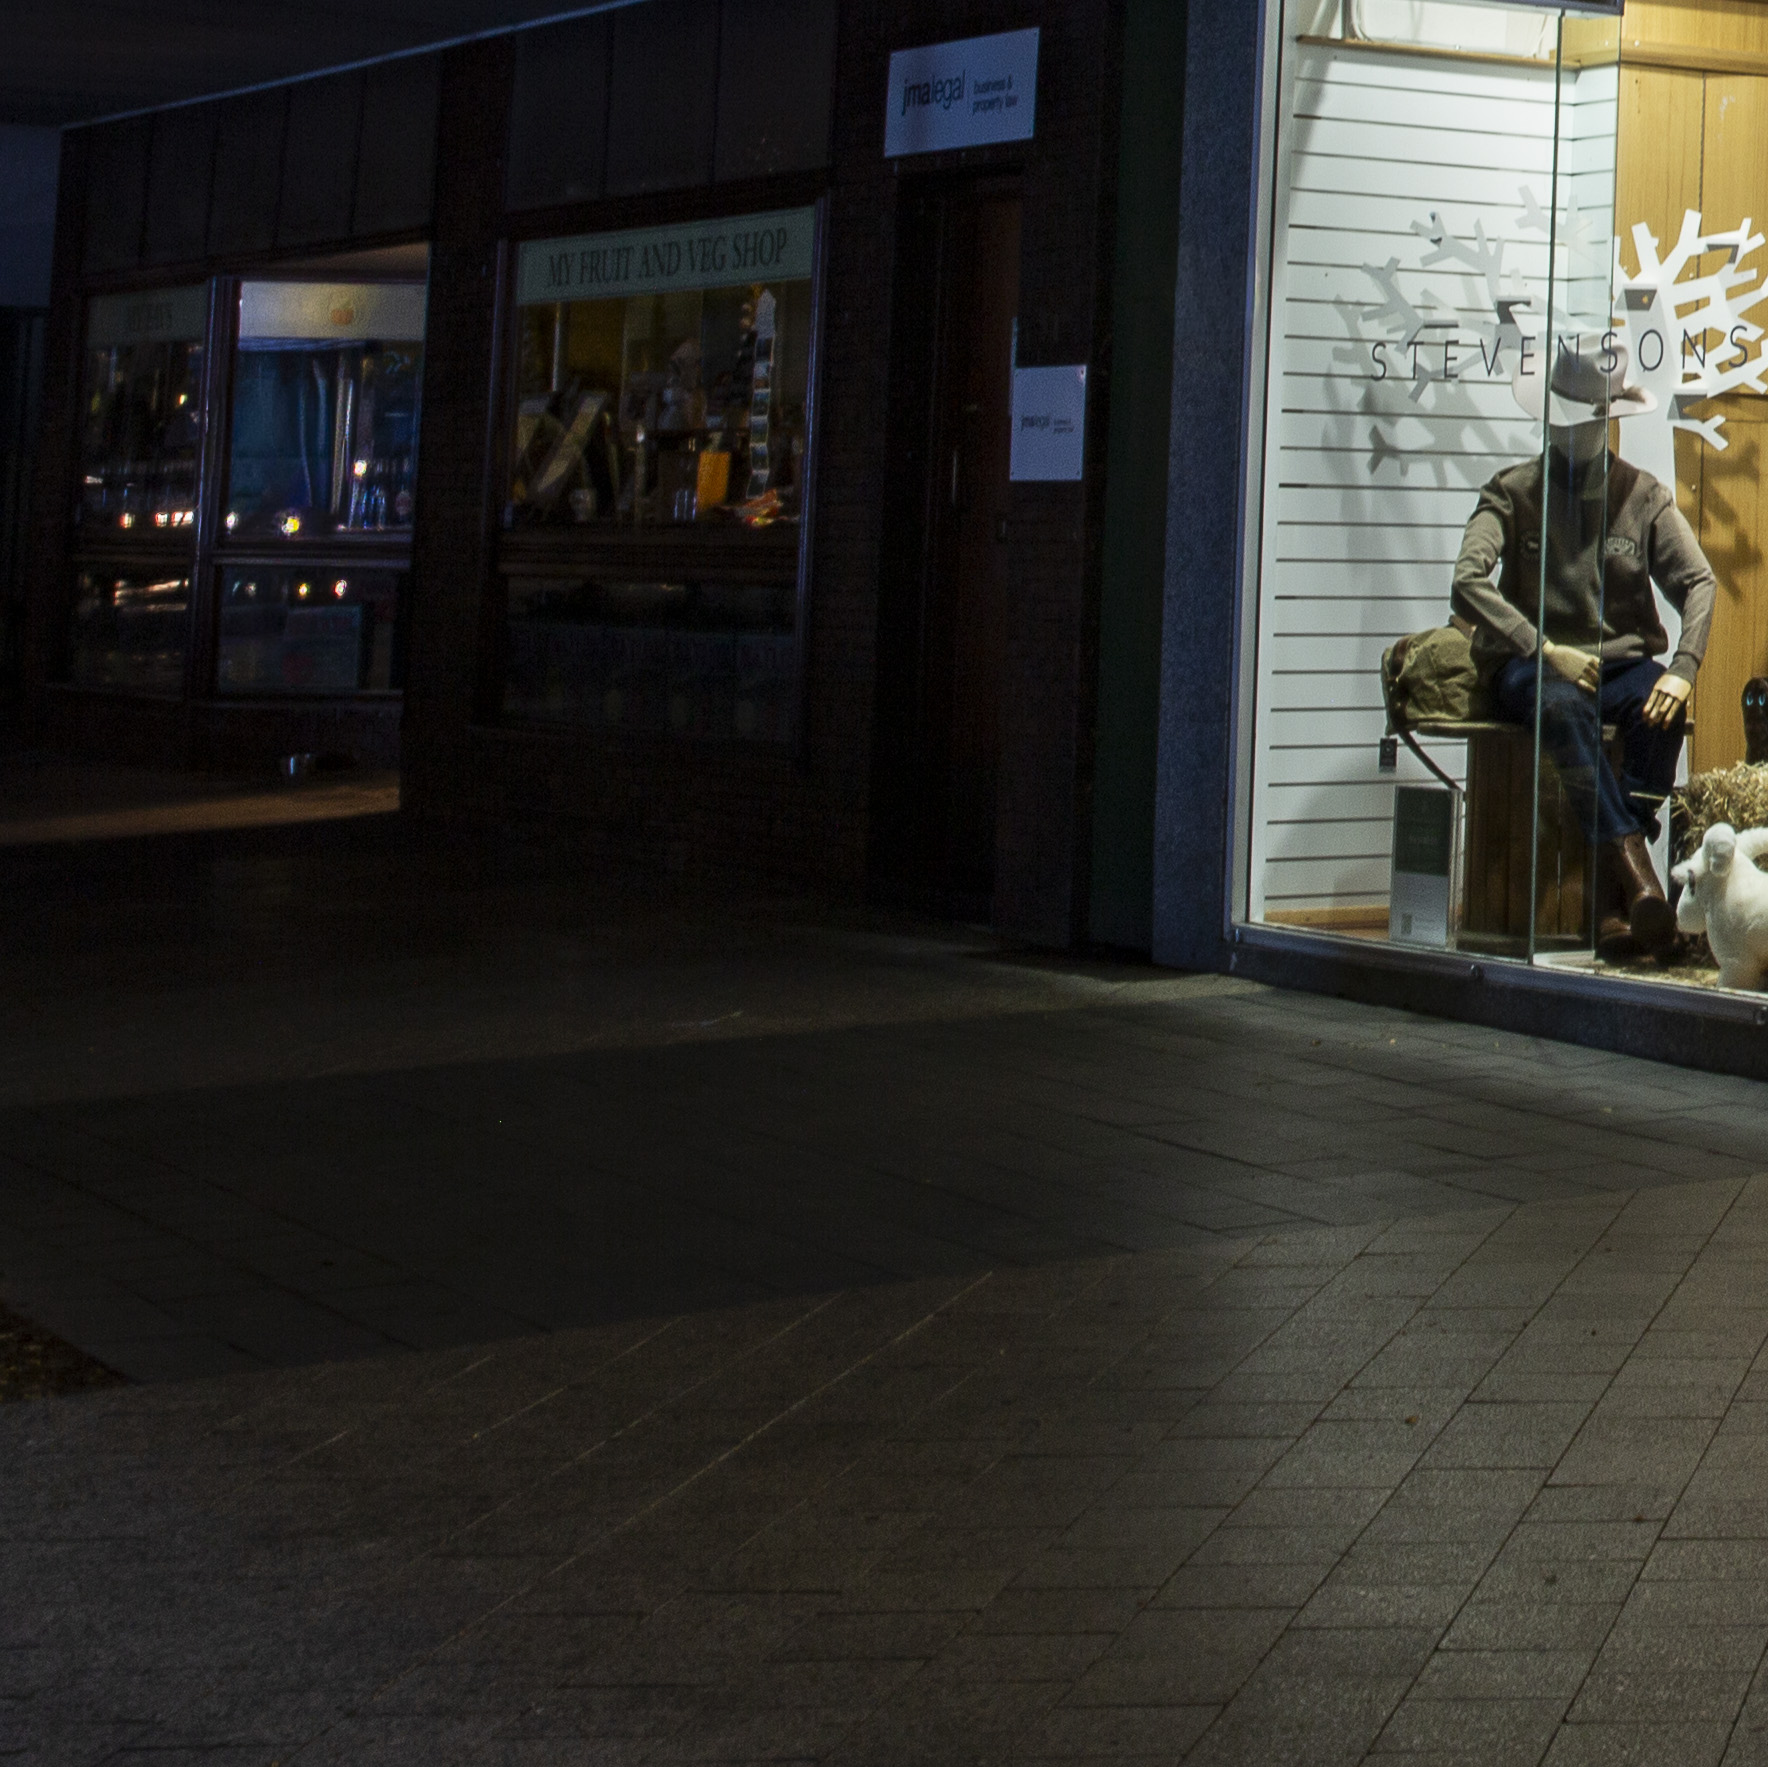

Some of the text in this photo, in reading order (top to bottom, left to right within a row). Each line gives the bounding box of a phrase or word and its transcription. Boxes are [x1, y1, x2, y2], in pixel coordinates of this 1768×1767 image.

[549, 226, 788, 287] MY FRUIT AND VEG SHOP
[1371, 325, 1749, 382] STEVENSONS
